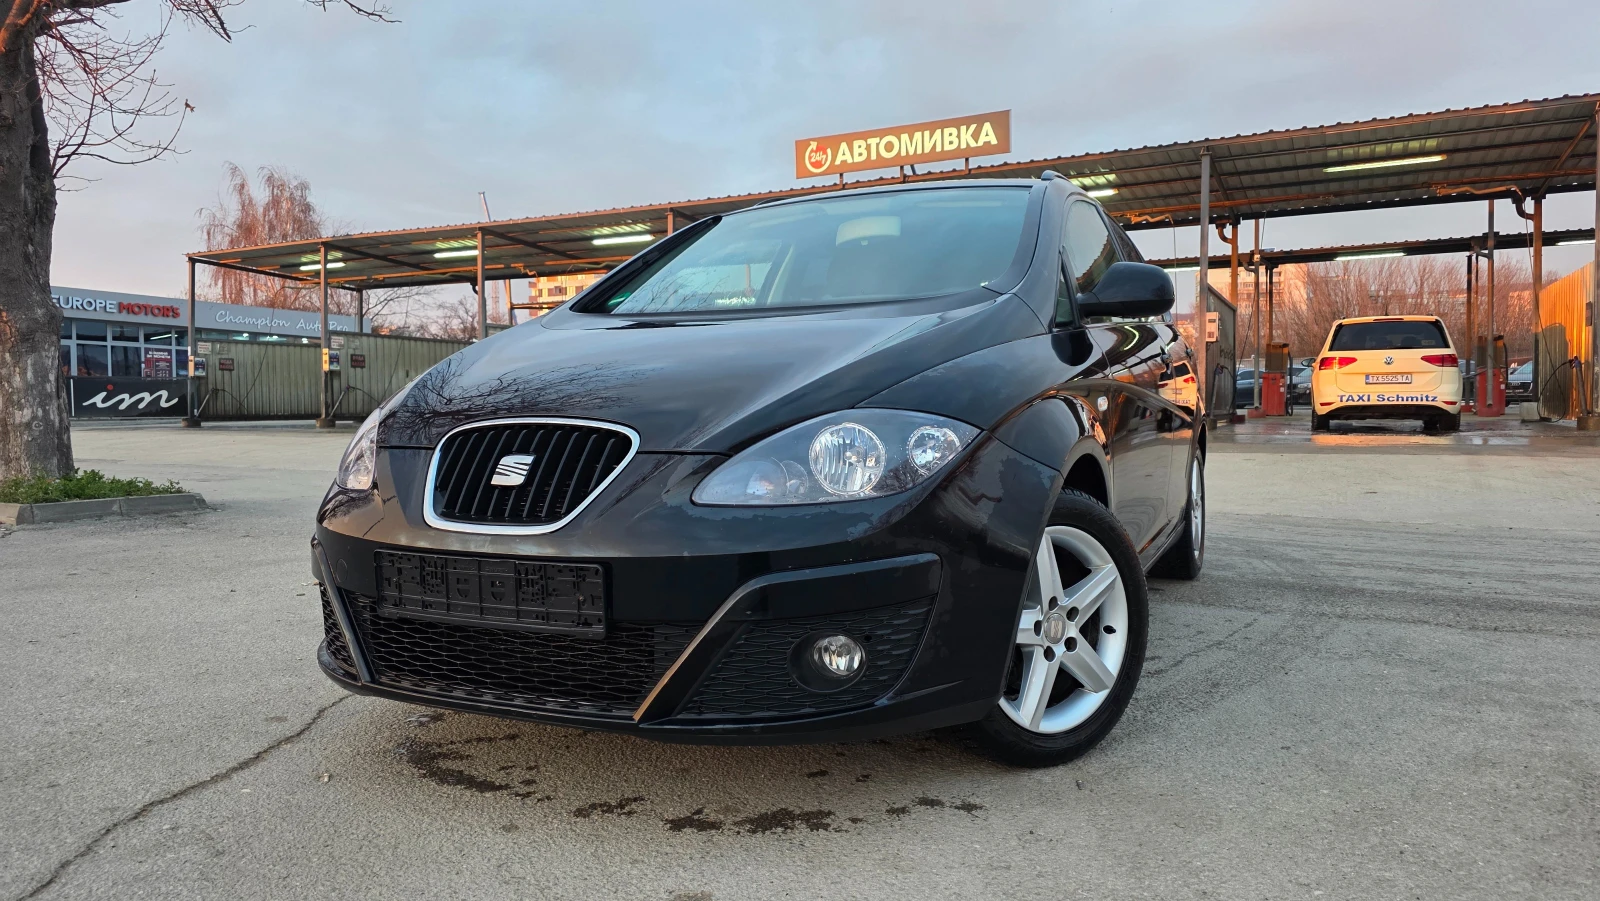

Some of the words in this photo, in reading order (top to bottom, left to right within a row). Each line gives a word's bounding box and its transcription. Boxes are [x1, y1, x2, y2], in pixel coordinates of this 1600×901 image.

[810, 151, 826, 165] 24/7
[834, 121, 998, 166] АВТОМИВКА
[215, 310, 291, 328] Champion
[1337, 394, 1371, 403] TAXI
[1376, 394, 1438, 403] Schmitz
